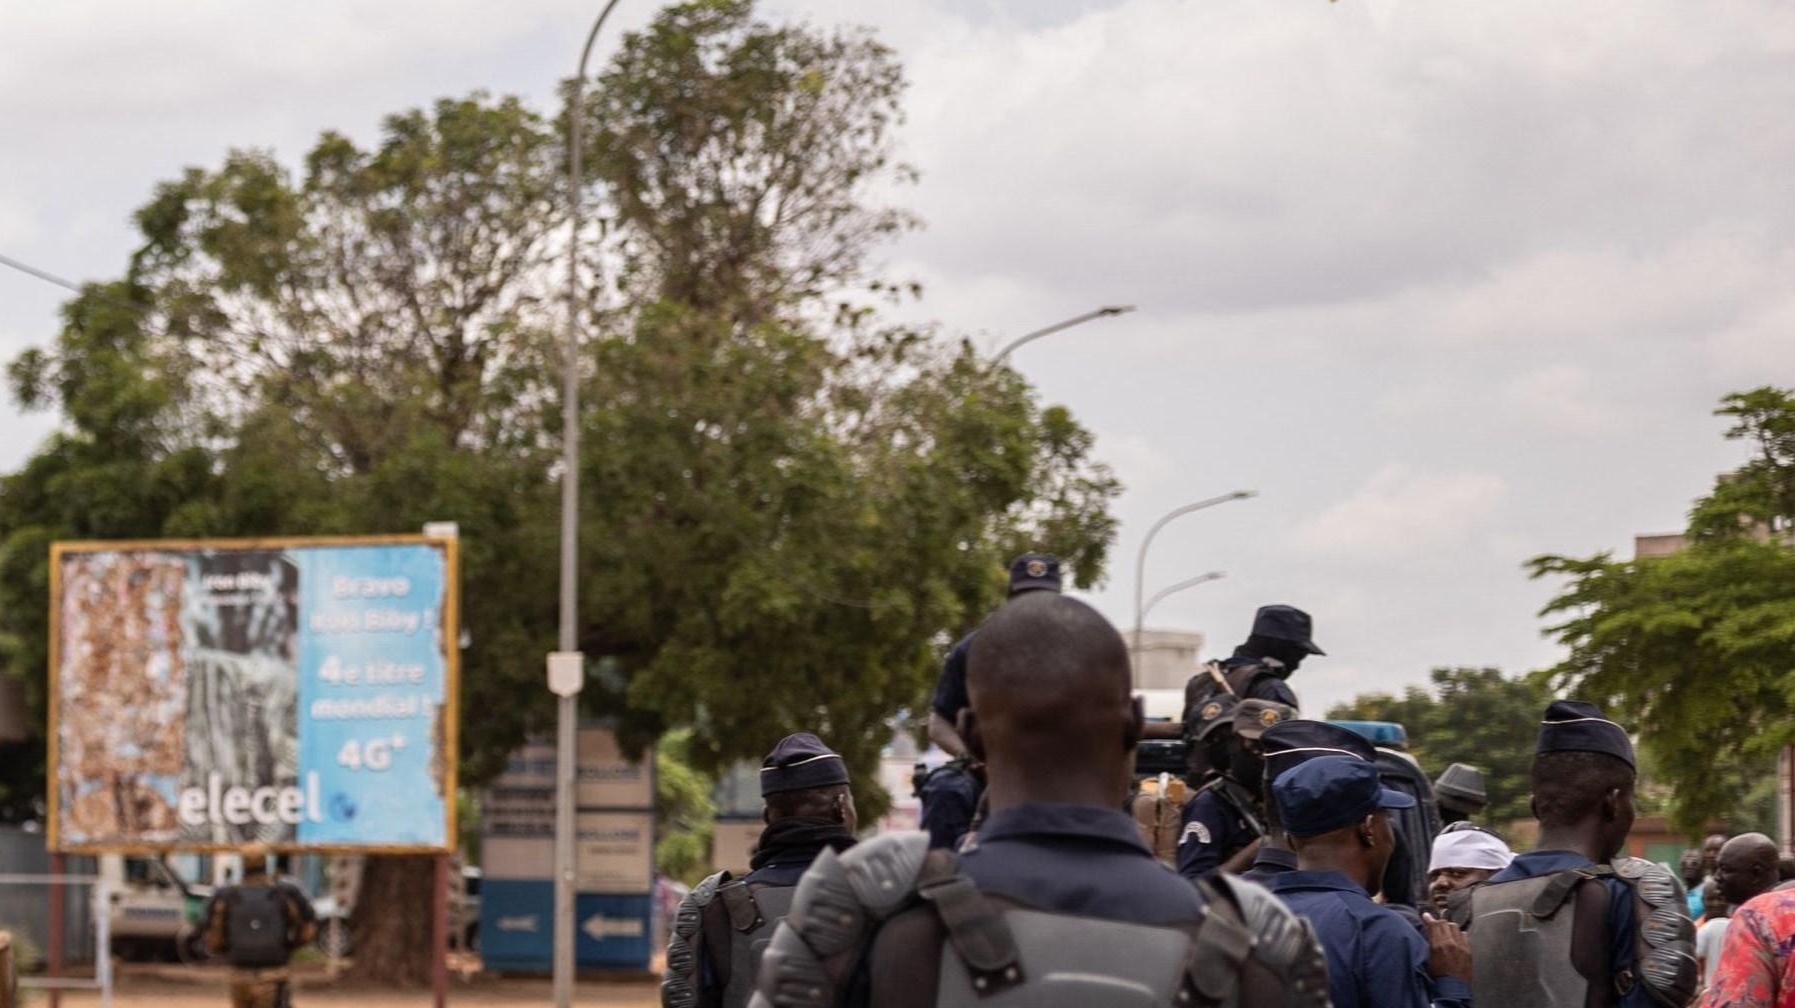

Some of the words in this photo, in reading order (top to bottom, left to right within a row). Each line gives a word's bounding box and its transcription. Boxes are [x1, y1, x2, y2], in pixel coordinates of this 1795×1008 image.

[332, 576, 410, 598] Bravo
[318, 654, 361, 686] 4e
[311, 693, 417, 720] mondial
